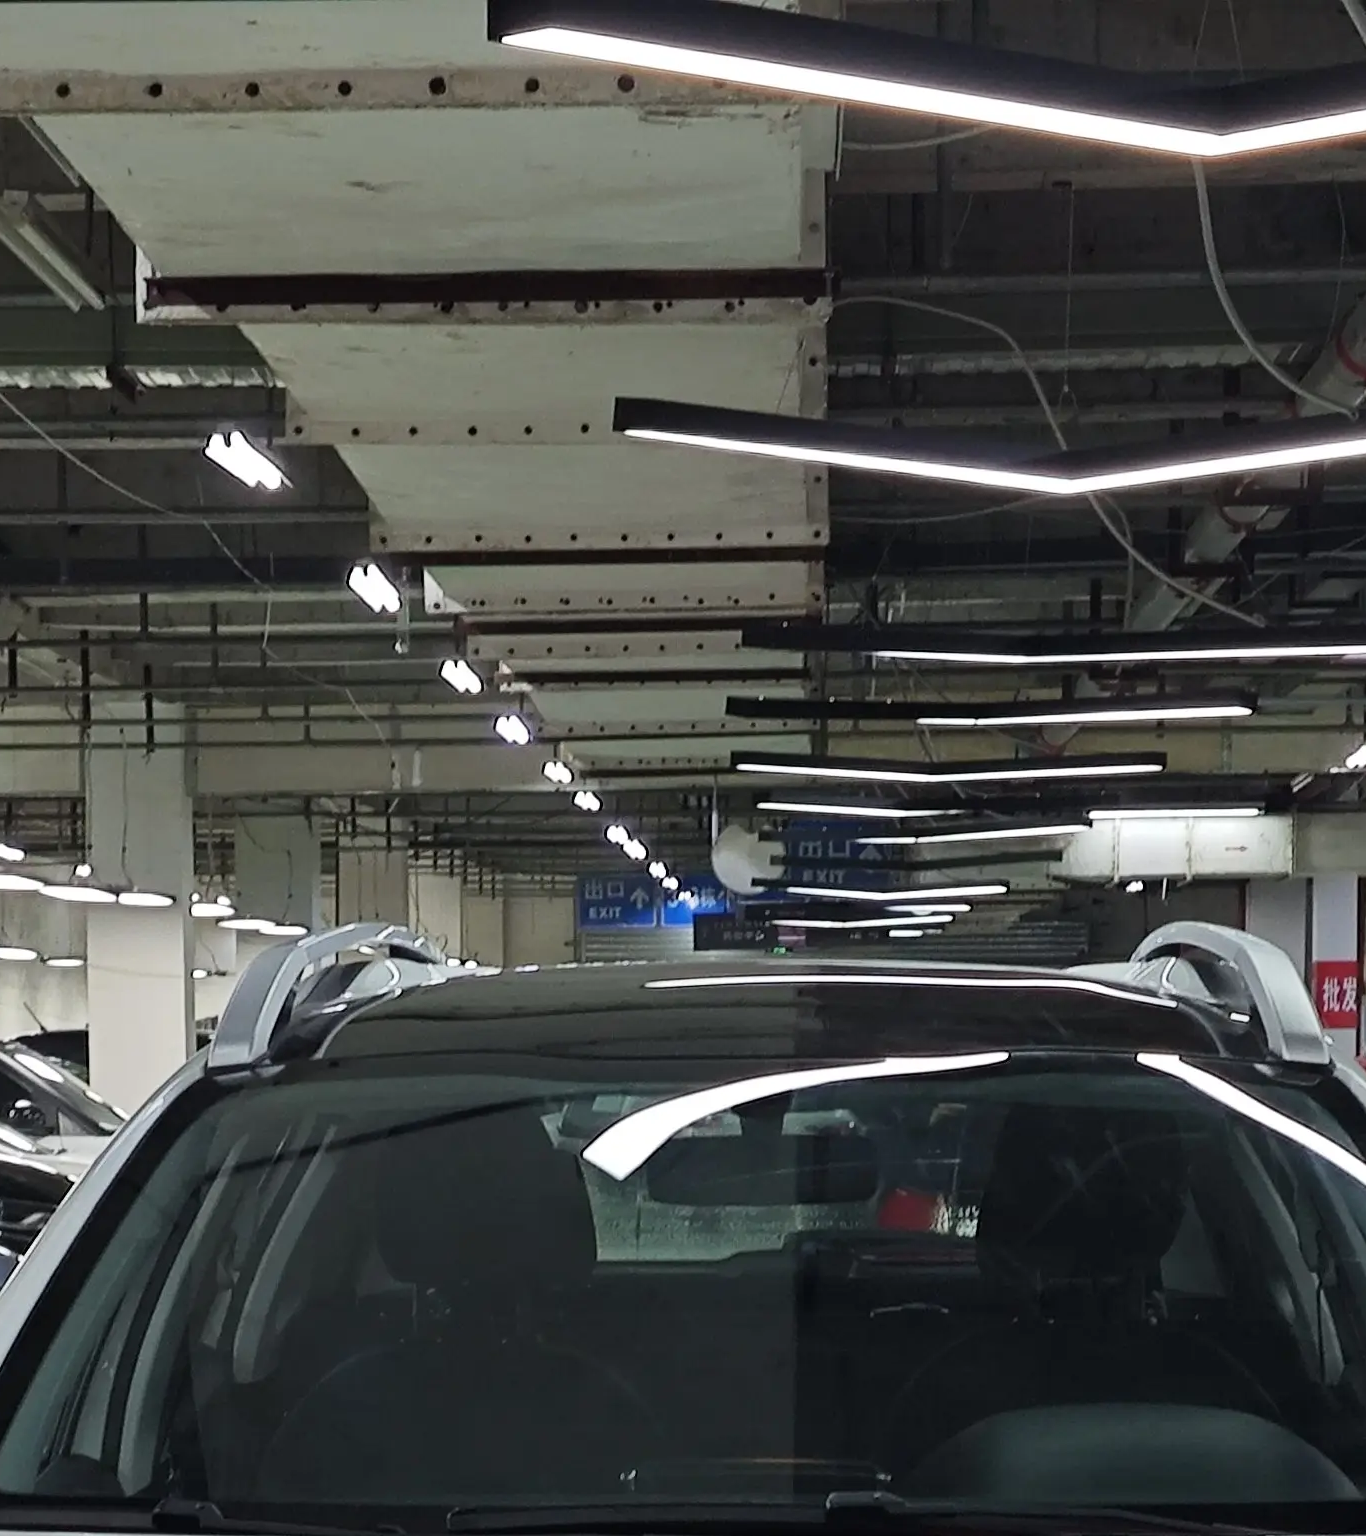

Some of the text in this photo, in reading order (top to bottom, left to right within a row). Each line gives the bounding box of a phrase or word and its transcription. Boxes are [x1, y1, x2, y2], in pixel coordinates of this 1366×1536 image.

[584, 880, 625, 900] 出口
[588, 905, 622, 920] EXIT
[1322, 975, 1358, 1013] 批发
